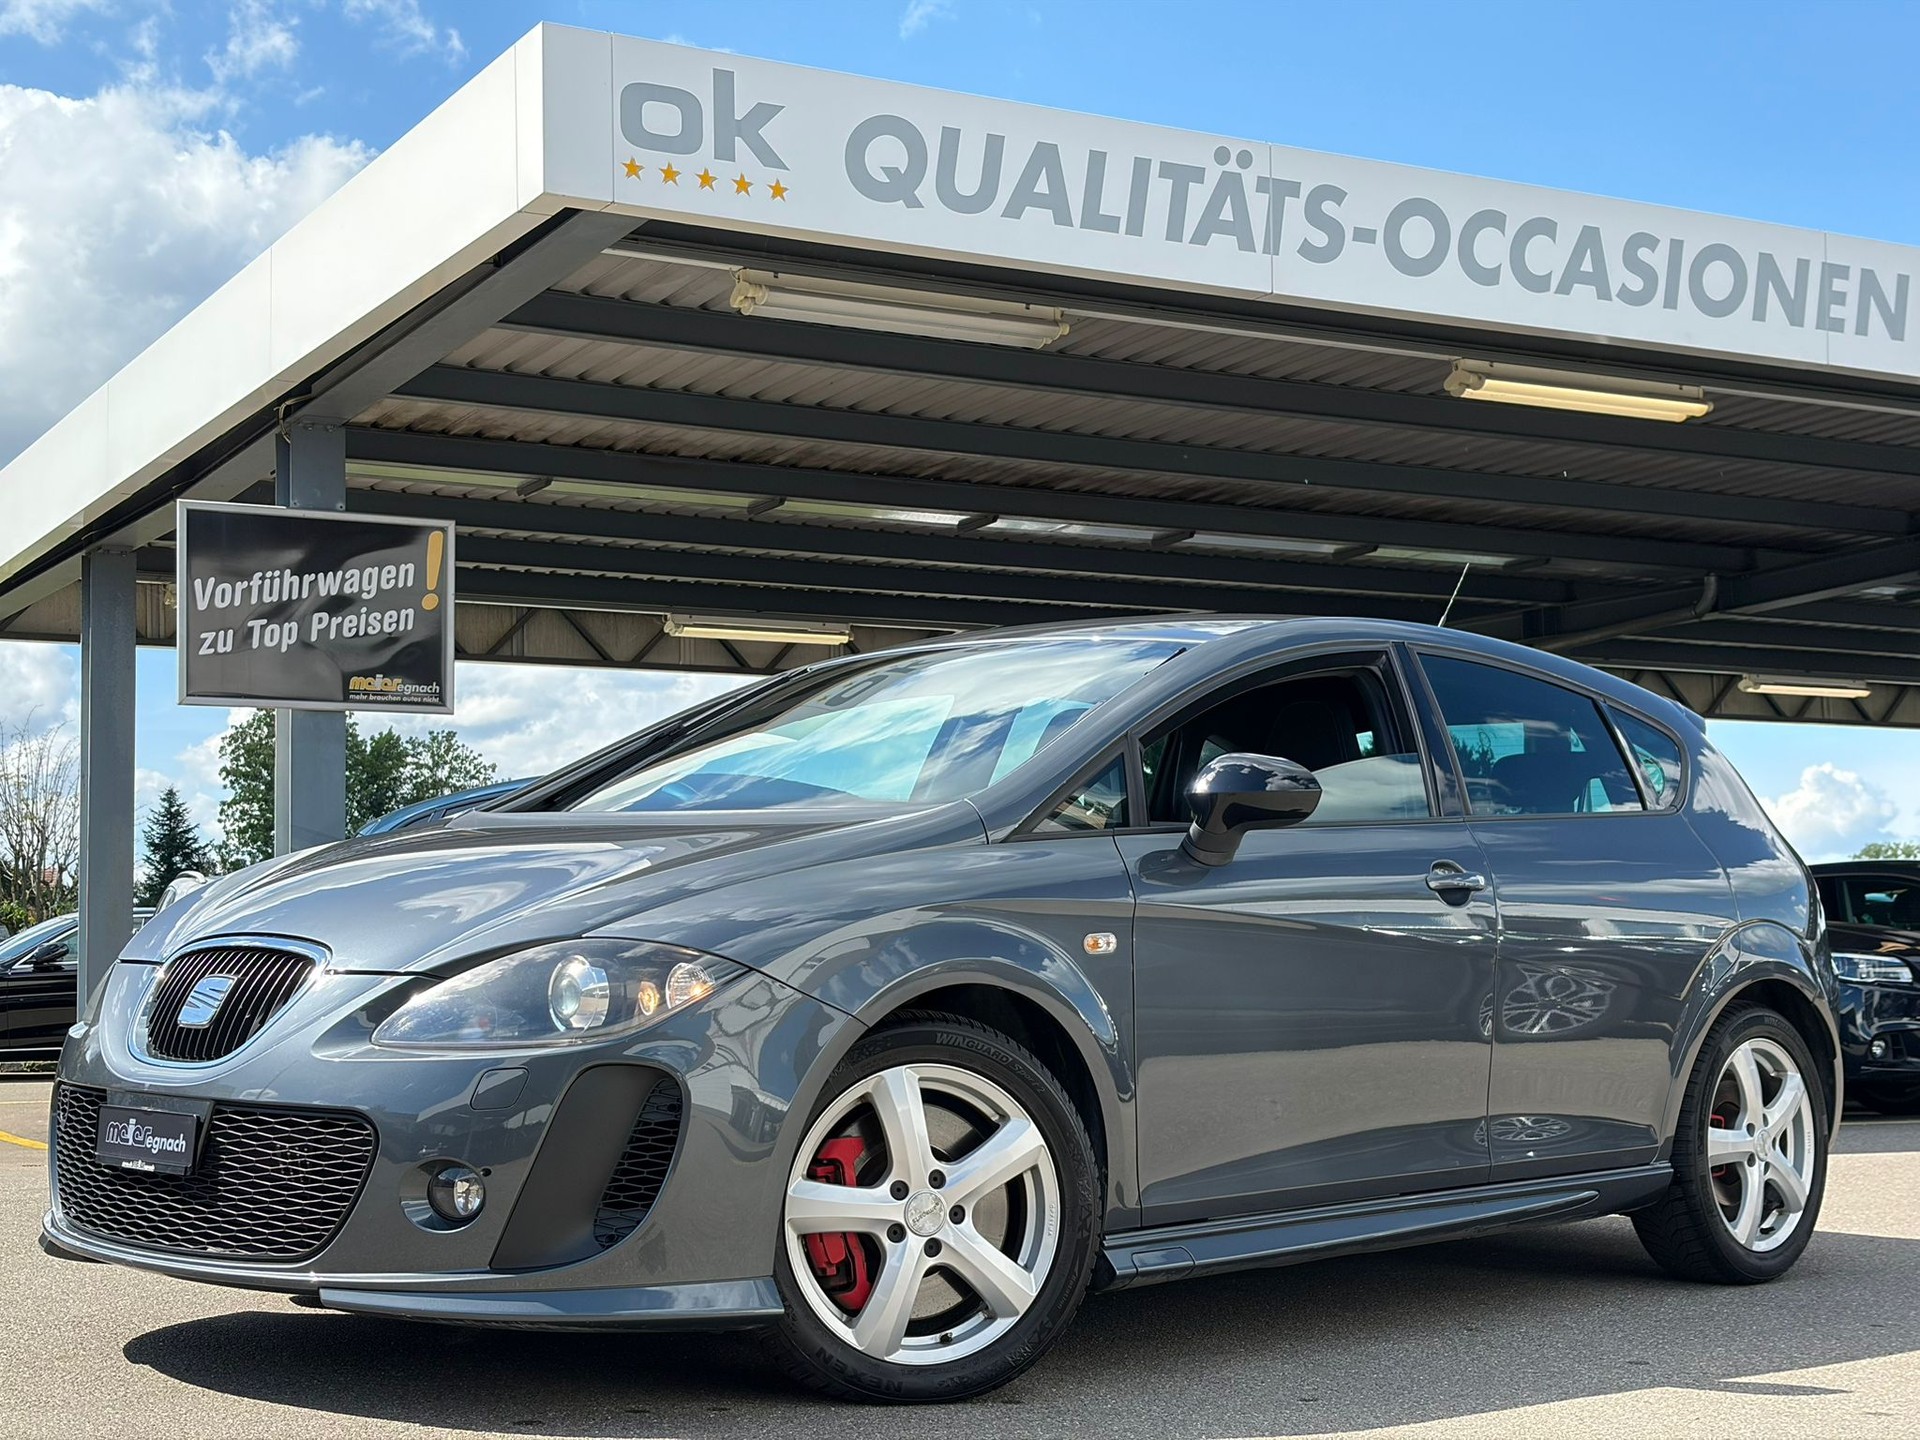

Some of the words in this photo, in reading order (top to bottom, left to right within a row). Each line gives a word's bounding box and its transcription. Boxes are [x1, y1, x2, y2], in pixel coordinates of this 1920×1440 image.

[620, 68, 790, 172] ok
[844, 114, 1910, 342] QUALITÄTS-OCCASIONEN
[194, 562, 415, 611] Vorführwagen
[198, 629, 234, 656] zu
[247, 618, 298, 653] Top
[310, 606, 415, 642] Preisen
[349, 692, 367, 701] mehr
[369, 693, 401, 702] brauchen
[402, 695, 421, 703] autos
[936, 1031, 1013, 1065] WINGUARD
[816, 1348, 904, 1393] NEXEN
